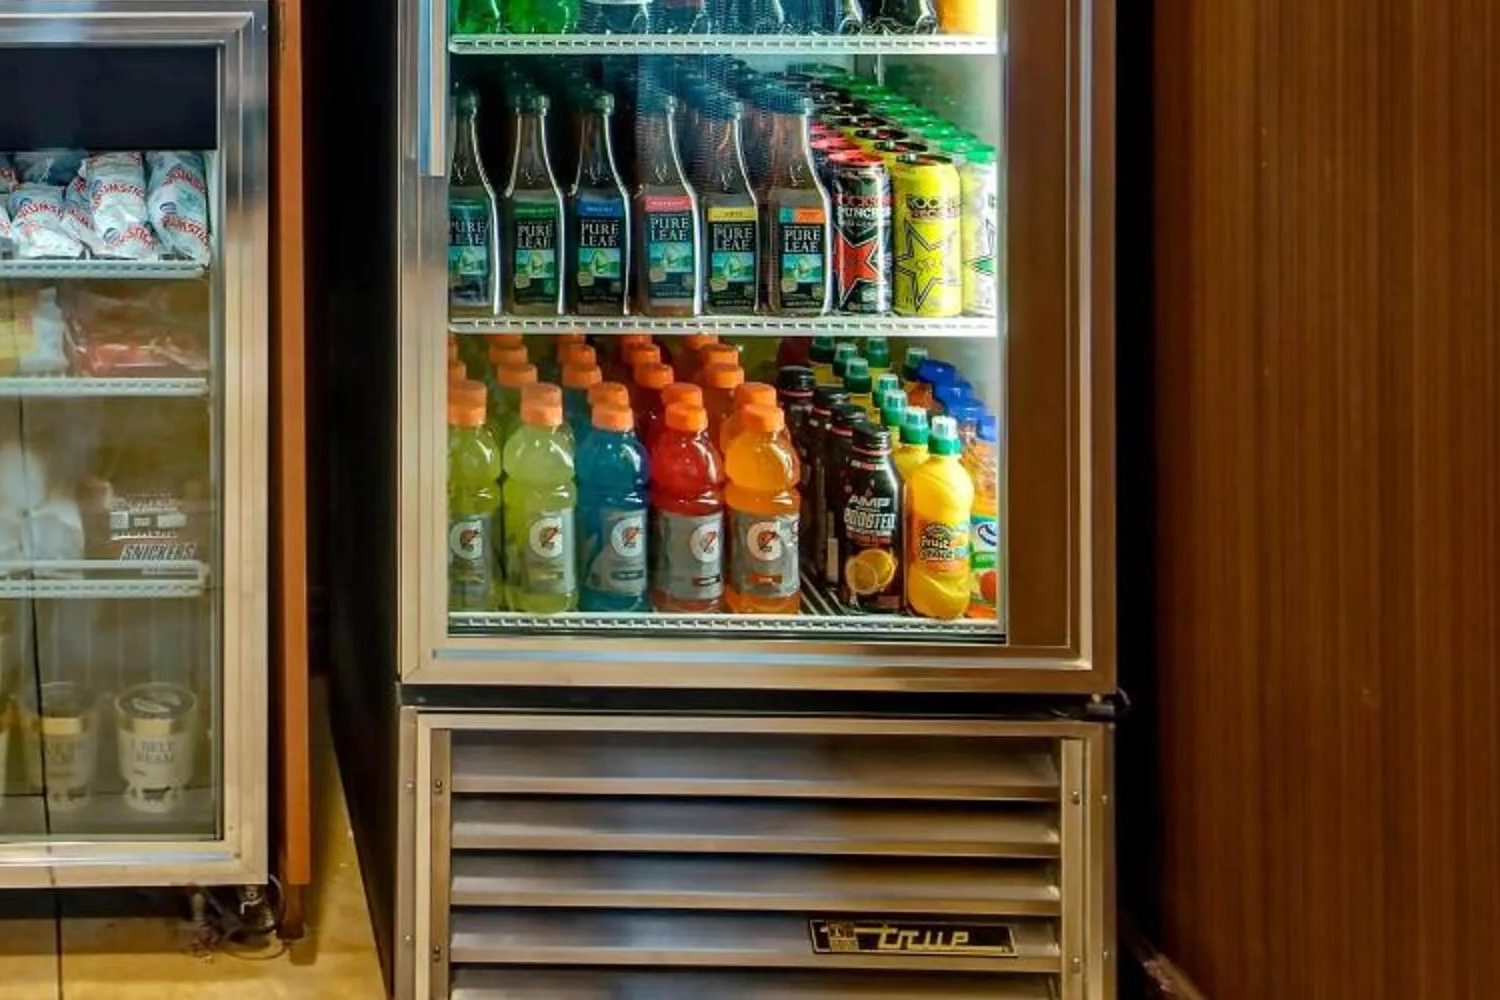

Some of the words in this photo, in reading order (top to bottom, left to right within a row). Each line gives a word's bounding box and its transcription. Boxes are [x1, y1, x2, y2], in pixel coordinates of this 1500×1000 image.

[581, 222, 619, 235] PURE
[651, 216, 689, 229] PURE
[651, 229, 688, 241] LEAF
[713, 227, 754, 240] PURE
[783, 228, 821, 241] PURE
[581, 235, 618, 247] LEAF
[713, 240, 750, 252] LEAF
[784, 241, 819, 253] LEAF
